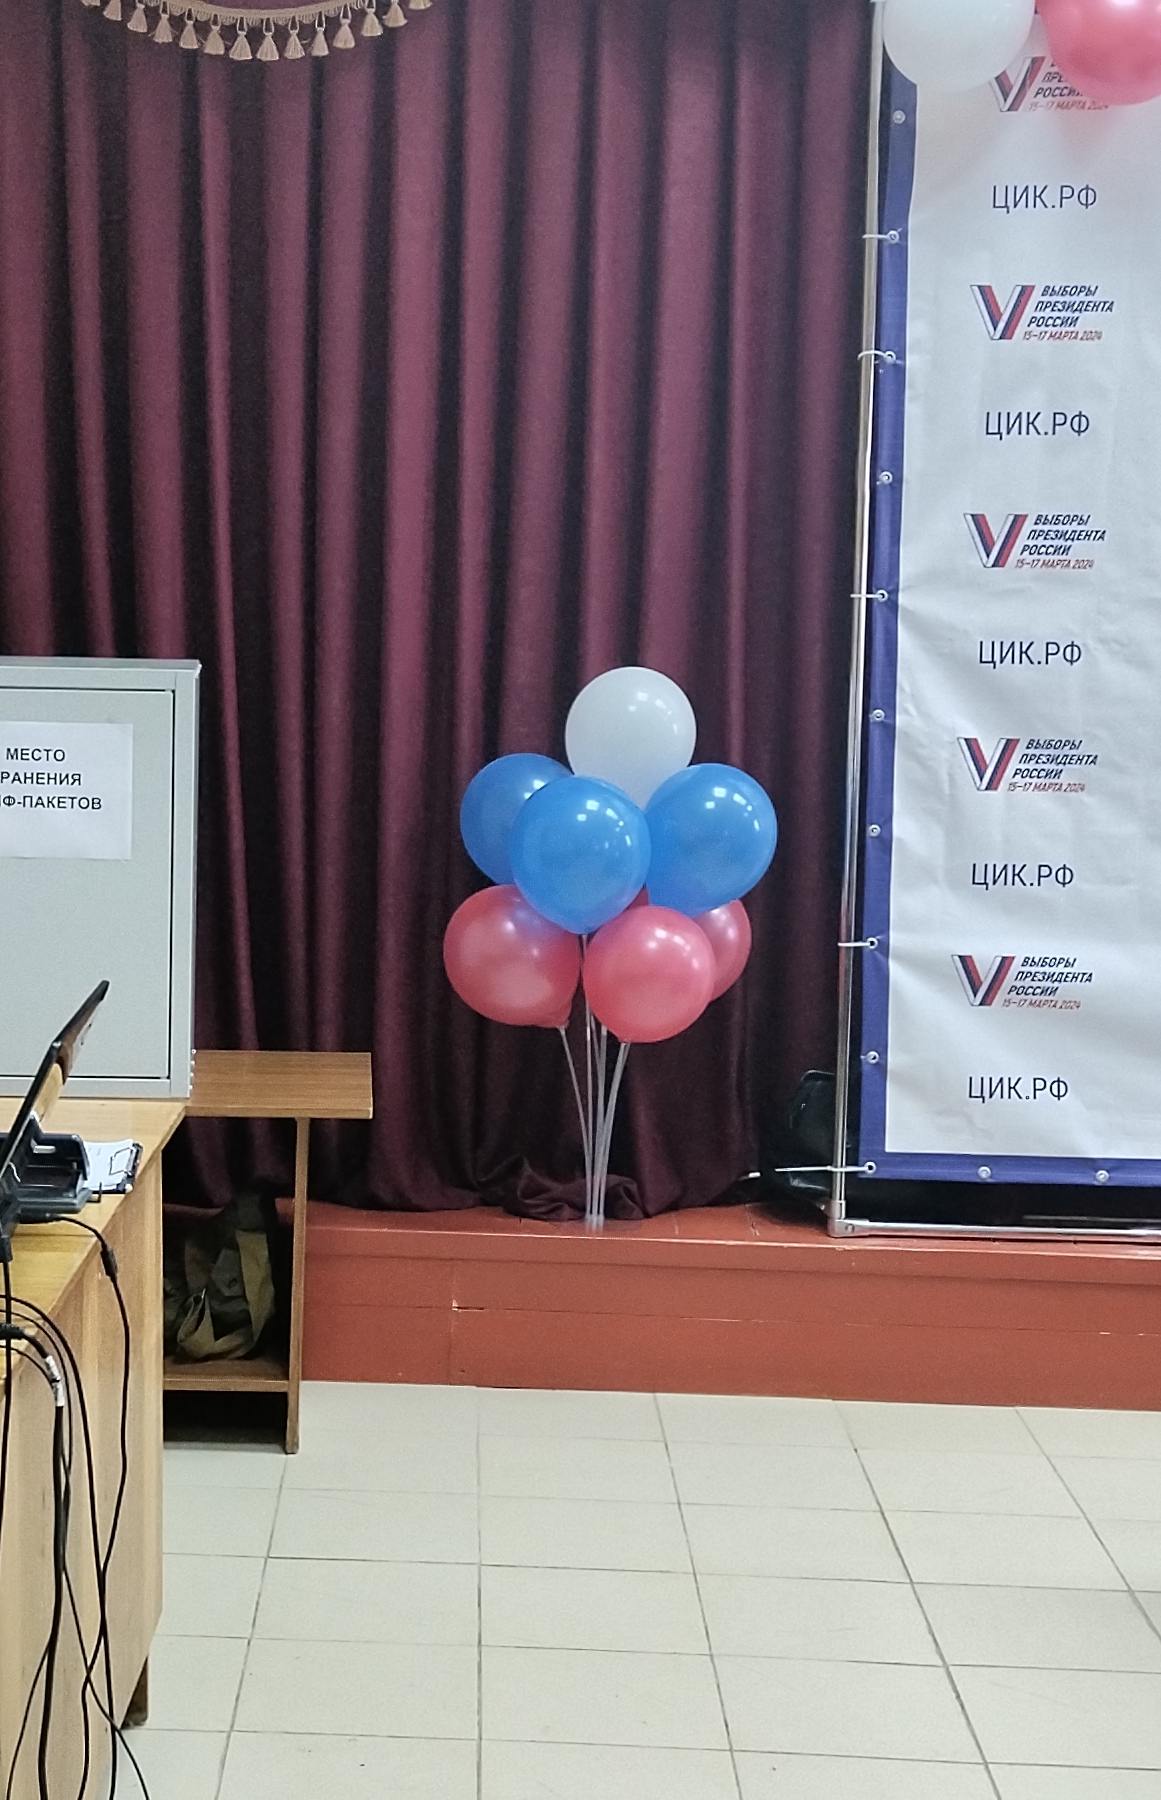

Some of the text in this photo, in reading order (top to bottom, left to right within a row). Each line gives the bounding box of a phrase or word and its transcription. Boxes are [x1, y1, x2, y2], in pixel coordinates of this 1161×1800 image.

[992, 184, 1097, 214] ЦИК.РФ
[1041, 285, 1099, 297] ВЫБОРЫ
[1034, 301, 1115, 313] ПРЕЗИДЕНТА
[1027, 316, 1080, 327] РОССИИ
[1047, 331, 1078, 340] МАРТА
[985, 411, 1090, 440] ЦИК.РФ
[1033, 514, 1091, 525] ВЫБОРЫ
[1026, 530, 1106, 541] ПРЕЗИДЕНТА
[1020, 544, 1072, 556] РОССИИ
[1040, 559, 1071, 569] МАРТА
[979, 641, 1082, 669] ЦИК.РФ
[1025, 738, 1083, 750] ВЫБОРЫ
[6, 748, 66, 762] МЕСТО
[1018, 754, 1098, 766] ПРЕЗИДЕНТА
[1012, 768, 1063, 779] РОССИИ
[1032, 783, 1062, 792] МАРТА
[972, 863, 1074, 891] ЦИК.РФ
[1021, 956, 1077, 968] ВЫБОРЫ
[1014, 971, 1093, 983] ПРЕЗИДЕНТА
[1007, 985, 1059, 996] РОССИИ
[1027, 999, 1058, 1009] МАРТА
[968, 1076, 1069, 1104] ЦИК.РФ
